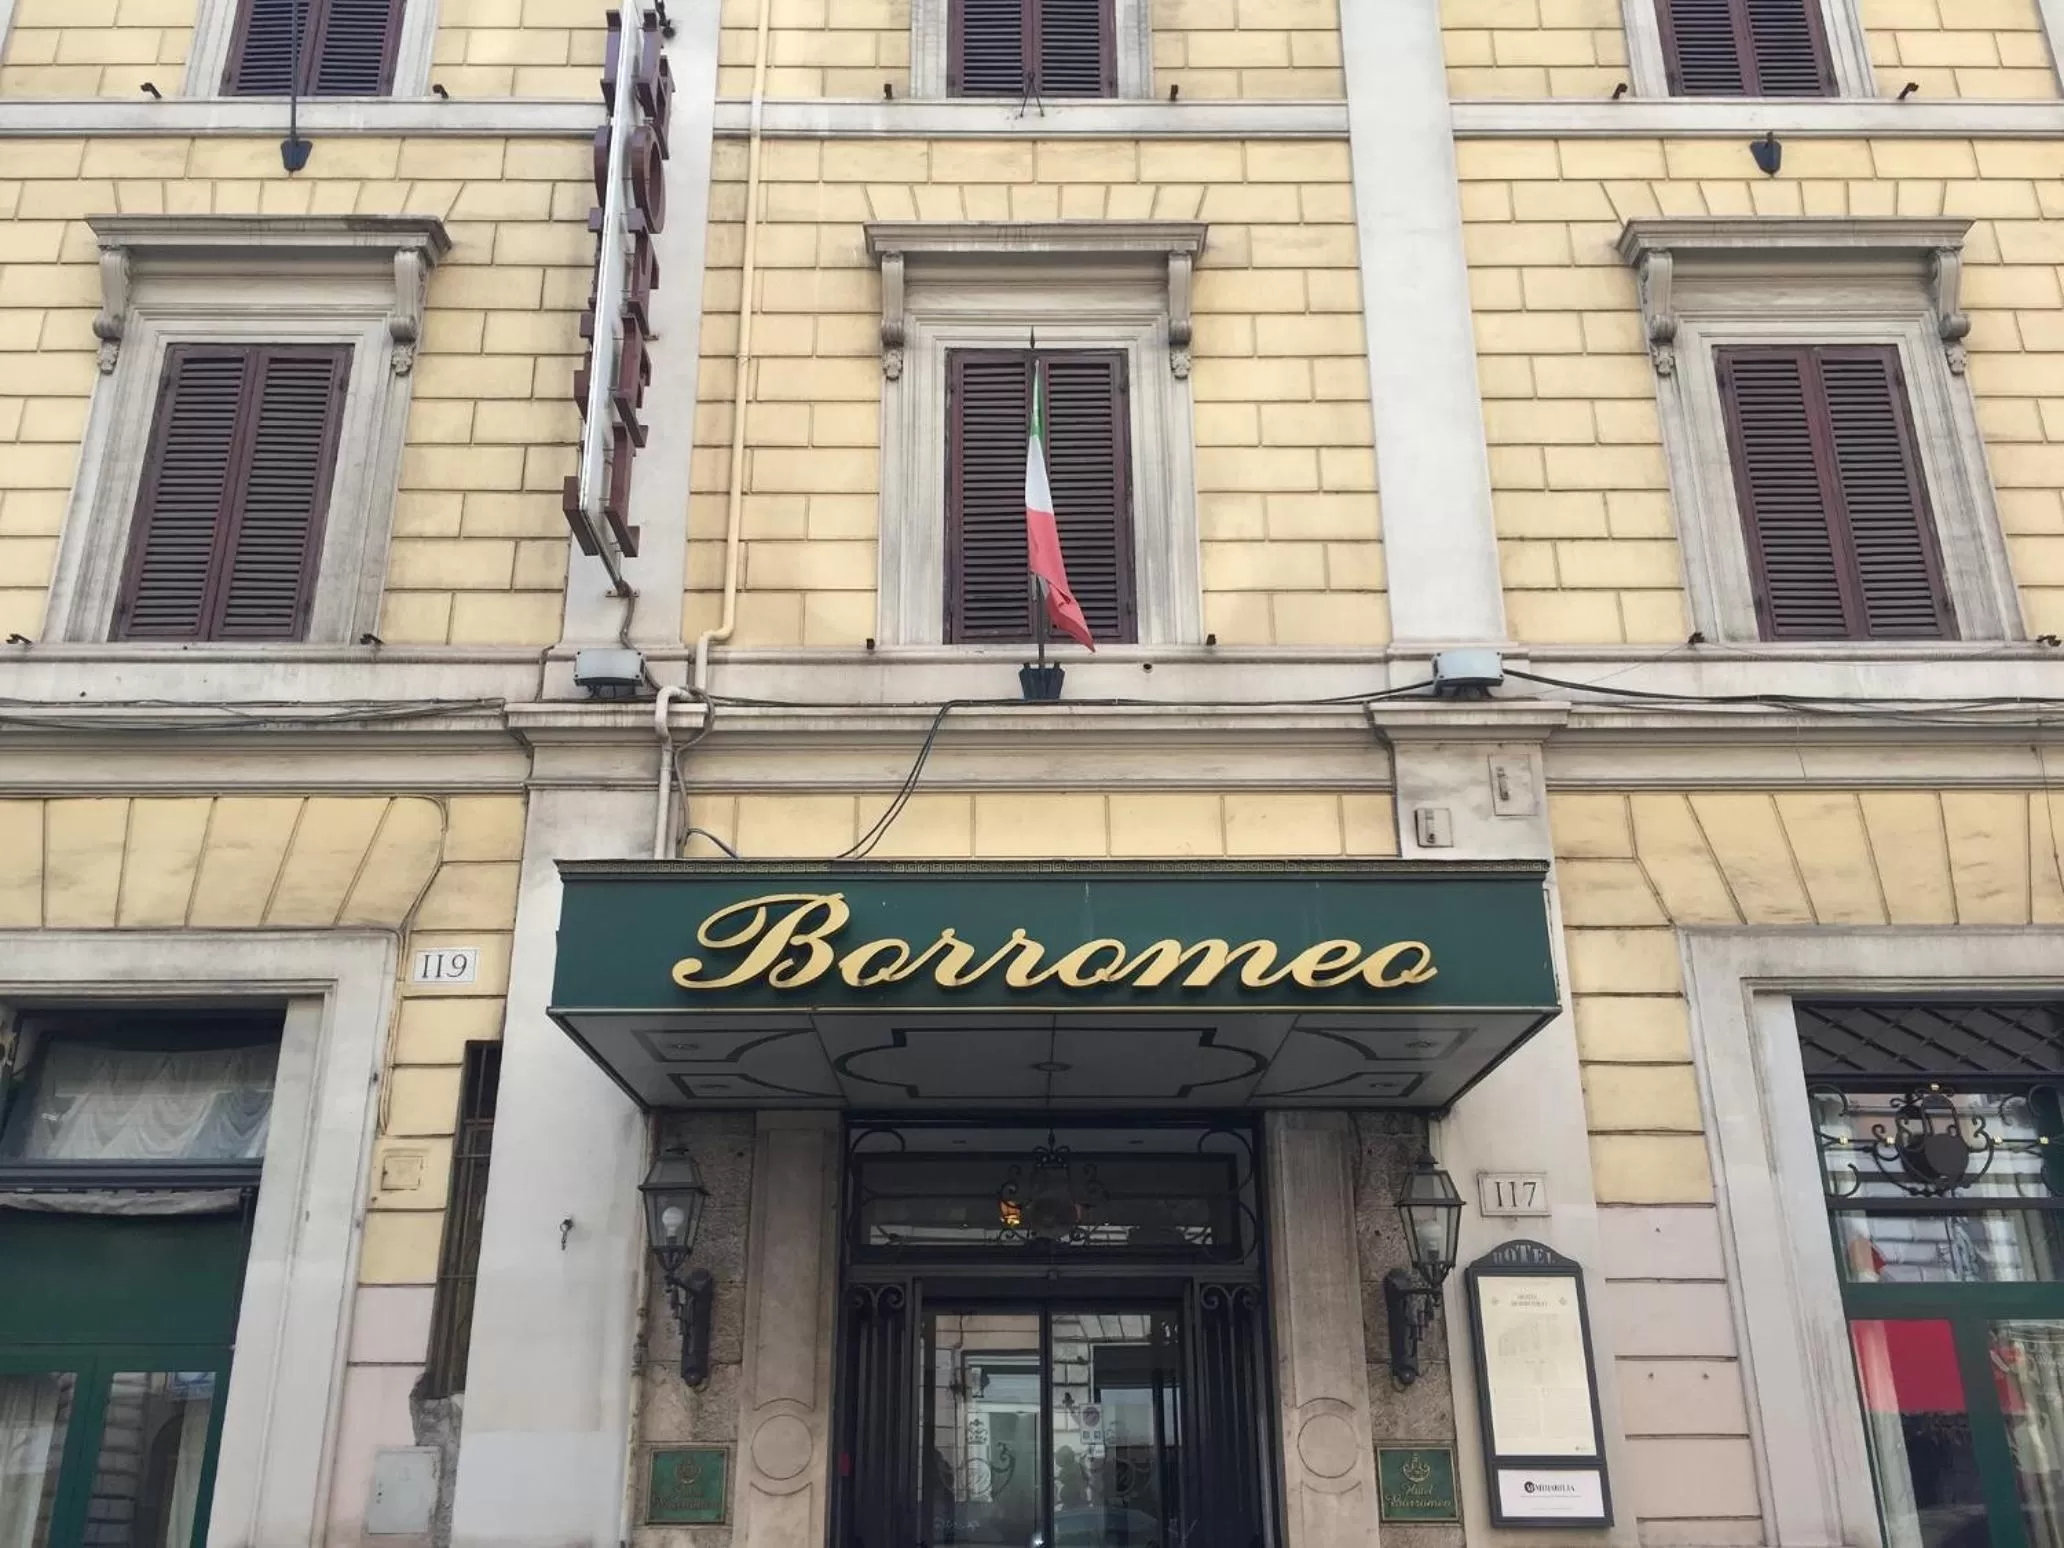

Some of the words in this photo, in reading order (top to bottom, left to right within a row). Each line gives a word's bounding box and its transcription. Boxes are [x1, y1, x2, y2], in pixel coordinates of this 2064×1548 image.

[672, 891, 1438, 990] Borromeo
[421, 953, 468, 979] 119
[1495, 1181, 1537, 1208] 117
[1492, 1244, 1556, 1265] HOTEL
